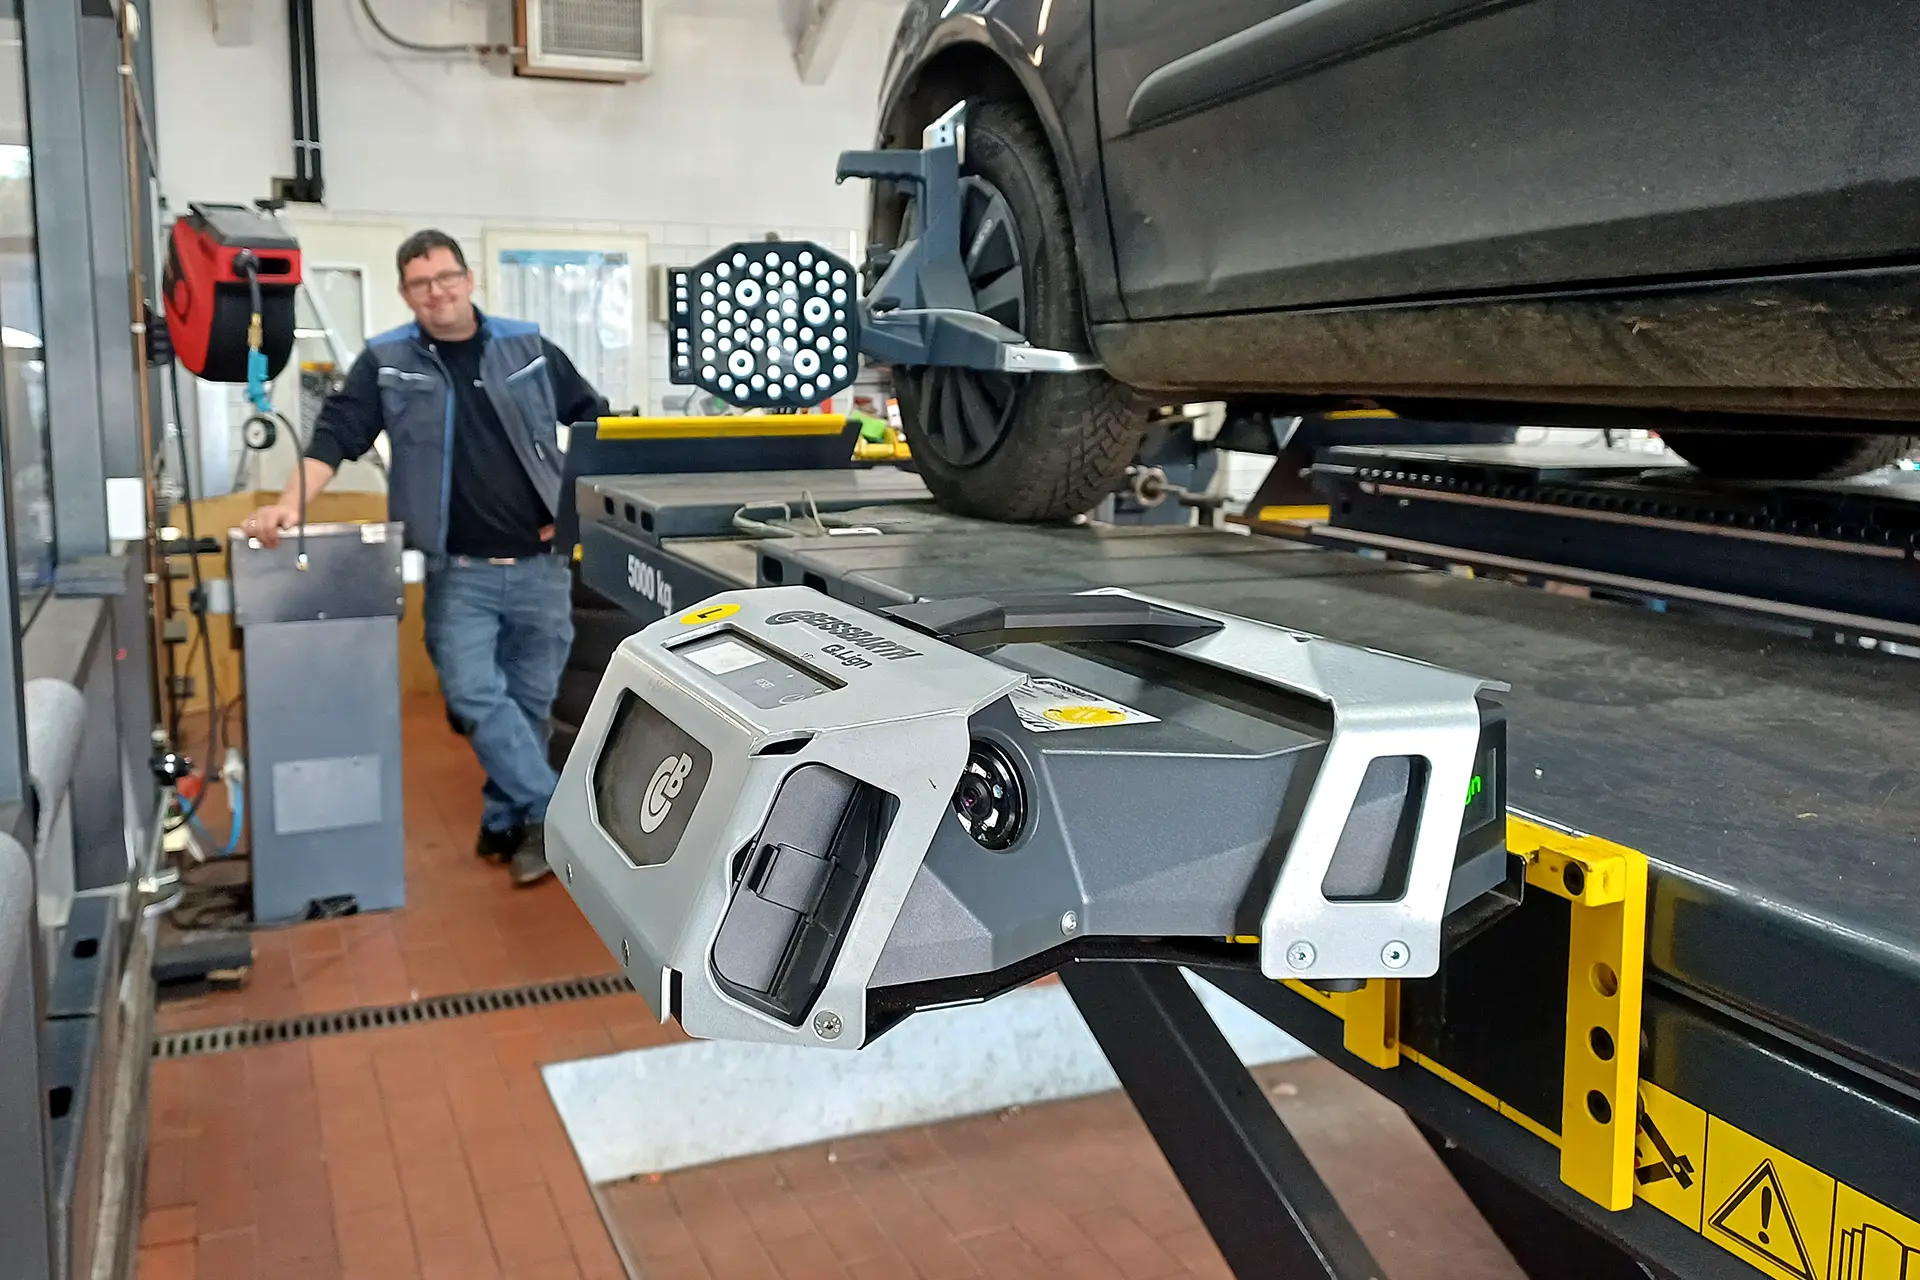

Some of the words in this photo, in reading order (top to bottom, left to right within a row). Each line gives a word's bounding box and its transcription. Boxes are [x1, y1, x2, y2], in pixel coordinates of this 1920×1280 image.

[628, 553, 655, 601] 5000
[656, 569, 672, 616] kg
[821, 644, 873, 669] Q.Lign
